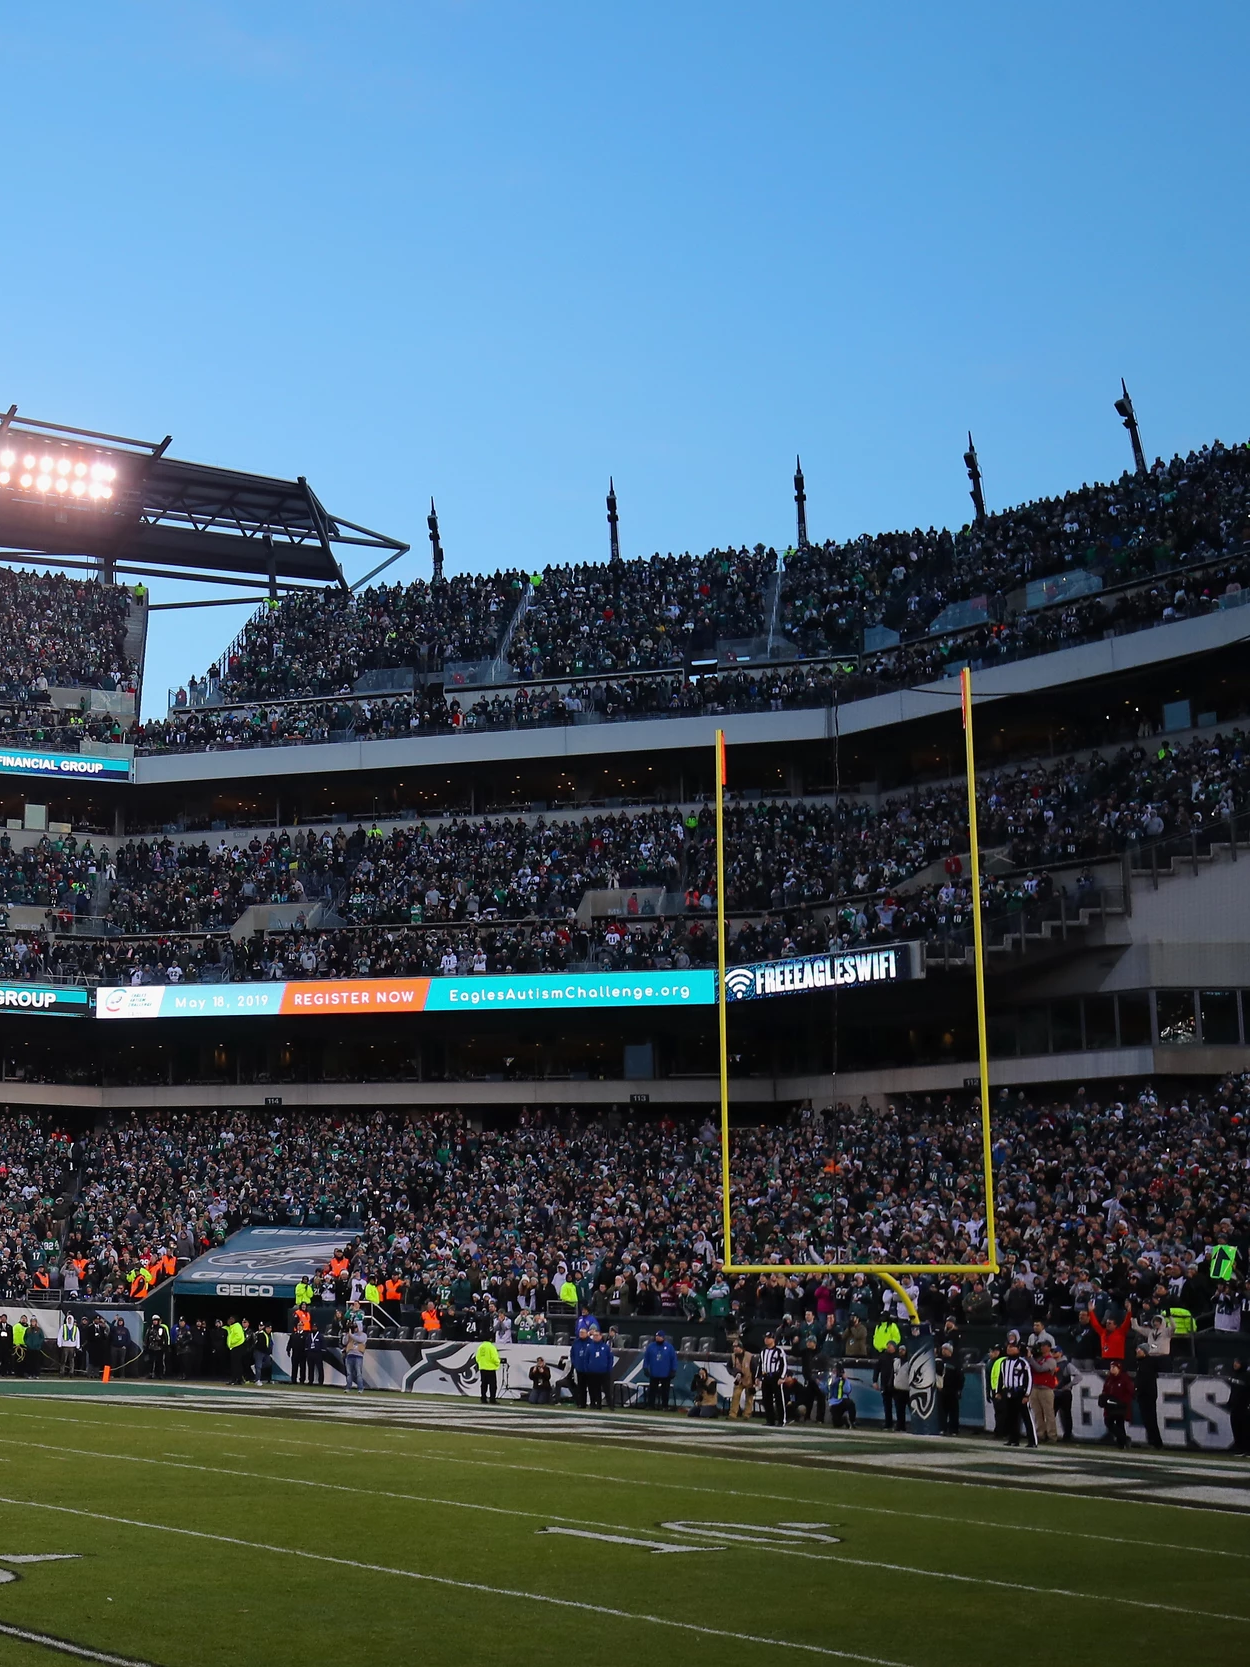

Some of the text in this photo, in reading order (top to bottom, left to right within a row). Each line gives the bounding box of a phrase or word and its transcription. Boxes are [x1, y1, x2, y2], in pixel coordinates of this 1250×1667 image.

[60, 760, 103, 774] GROUP
[755, 954, 896, 995] FREEEAGLESWIFI
[294, 991, 414, 1006] REGISTER NOW
[449, 986, 691, 1004] EaglesAutismChallenge.org
[175, 995, 268, 1010] May 18, 2019
[945, 1178, 952, 1186] 11
[352, 1204, 359, 1212] 11
[1077, 1205, 1086, 1213] 20
[572, 1261, 581, 1270] 11
[216, 1283, 274, 1297] GEICO
[441, 1290, 451, 1299] 17
[466, 1322, 477, 1332] 24
